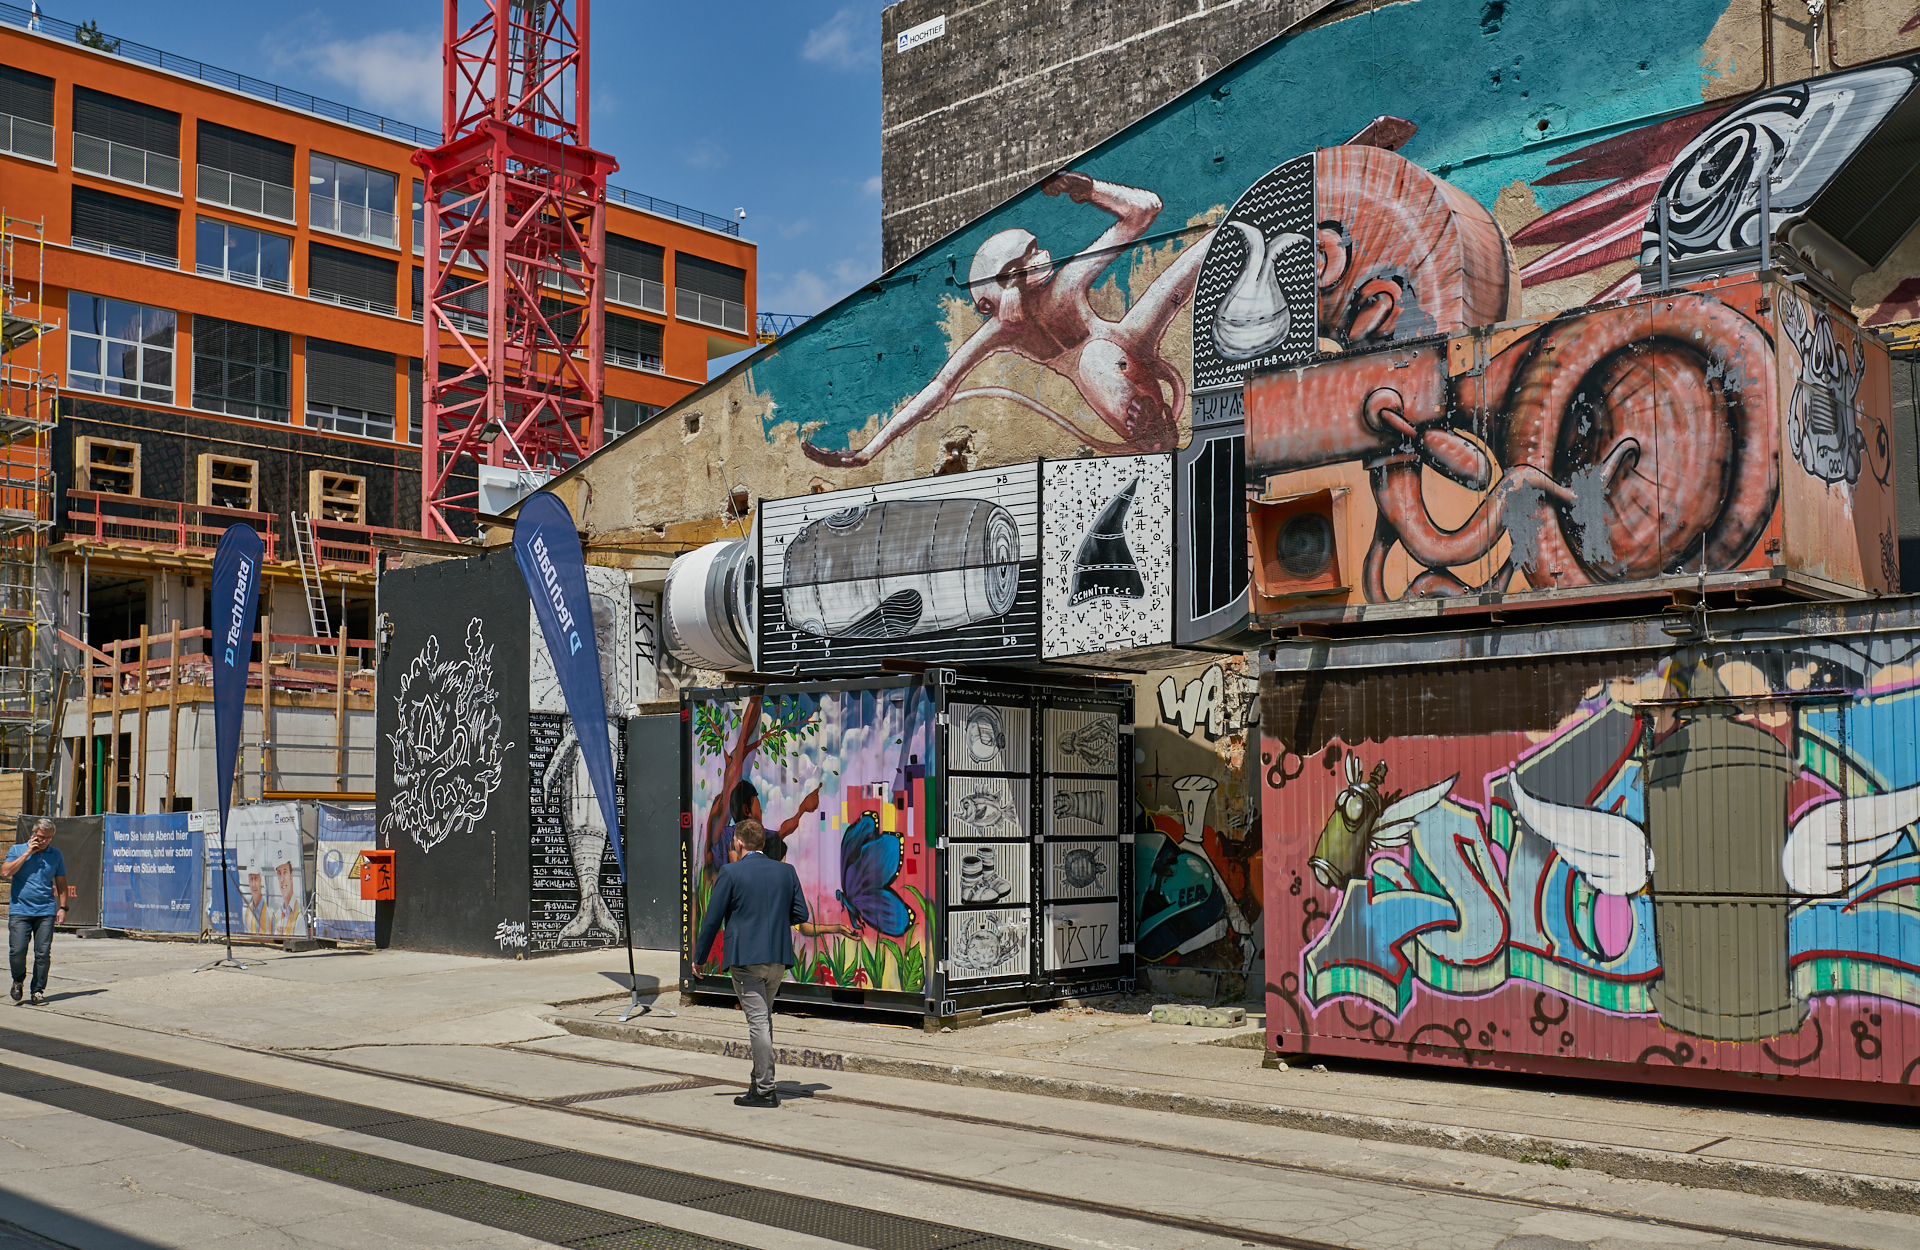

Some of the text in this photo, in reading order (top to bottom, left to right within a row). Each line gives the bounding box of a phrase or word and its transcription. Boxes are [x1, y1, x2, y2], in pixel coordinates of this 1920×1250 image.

[909, 24, 943, 44] HOCHTIEF
[1225, 358, 1262, 374] SCHNITT
[113, 830, 189, 842] Wenn Sie heute Abend hier
[112, 846, 193, 859] vorbeikommen, sind wir schon
[113, 863, 176, 874] wieder ein Stück weiter.
[681, 841, 689, 922] ALEXANDRE
